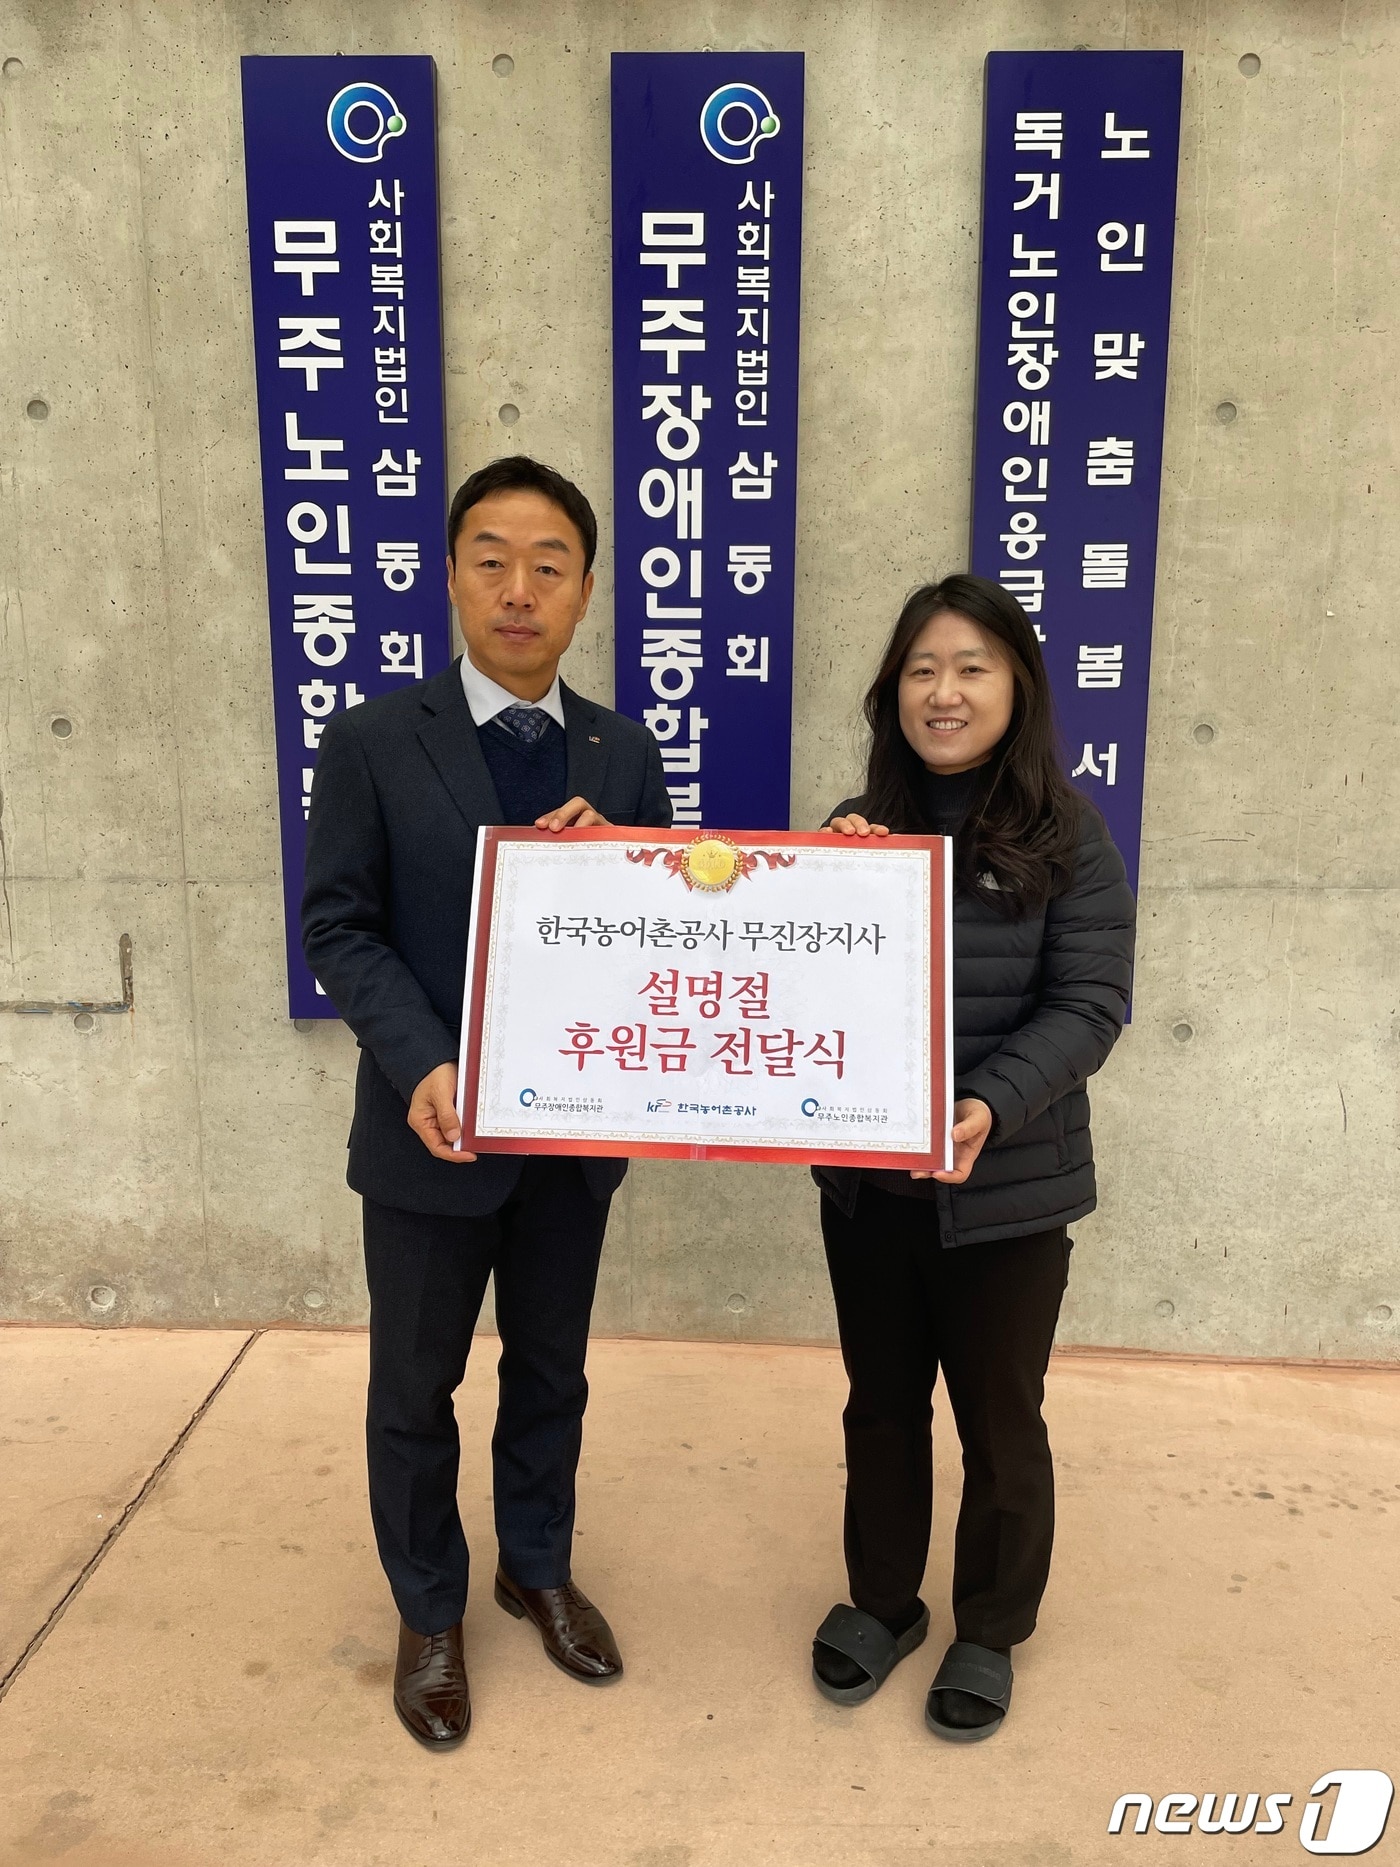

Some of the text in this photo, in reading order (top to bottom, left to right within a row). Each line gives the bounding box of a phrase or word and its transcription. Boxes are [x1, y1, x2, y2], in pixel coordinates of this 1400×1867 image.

[369, 179, 424, 679] 사회복지법인 삼동회
[726, 181, 778, 683] 사회복지법인 삼동회
[272, 219, 366, 820] 무주노인종합
[536, 915, 887, 956] 한국농어촌공사 무진장지사
[638, 968, 771, 1020] 설명절
[558, 1021, 846, 1080] 후원금 전달식
[677, 1102, 757, 1116] 한국농어촌공사
